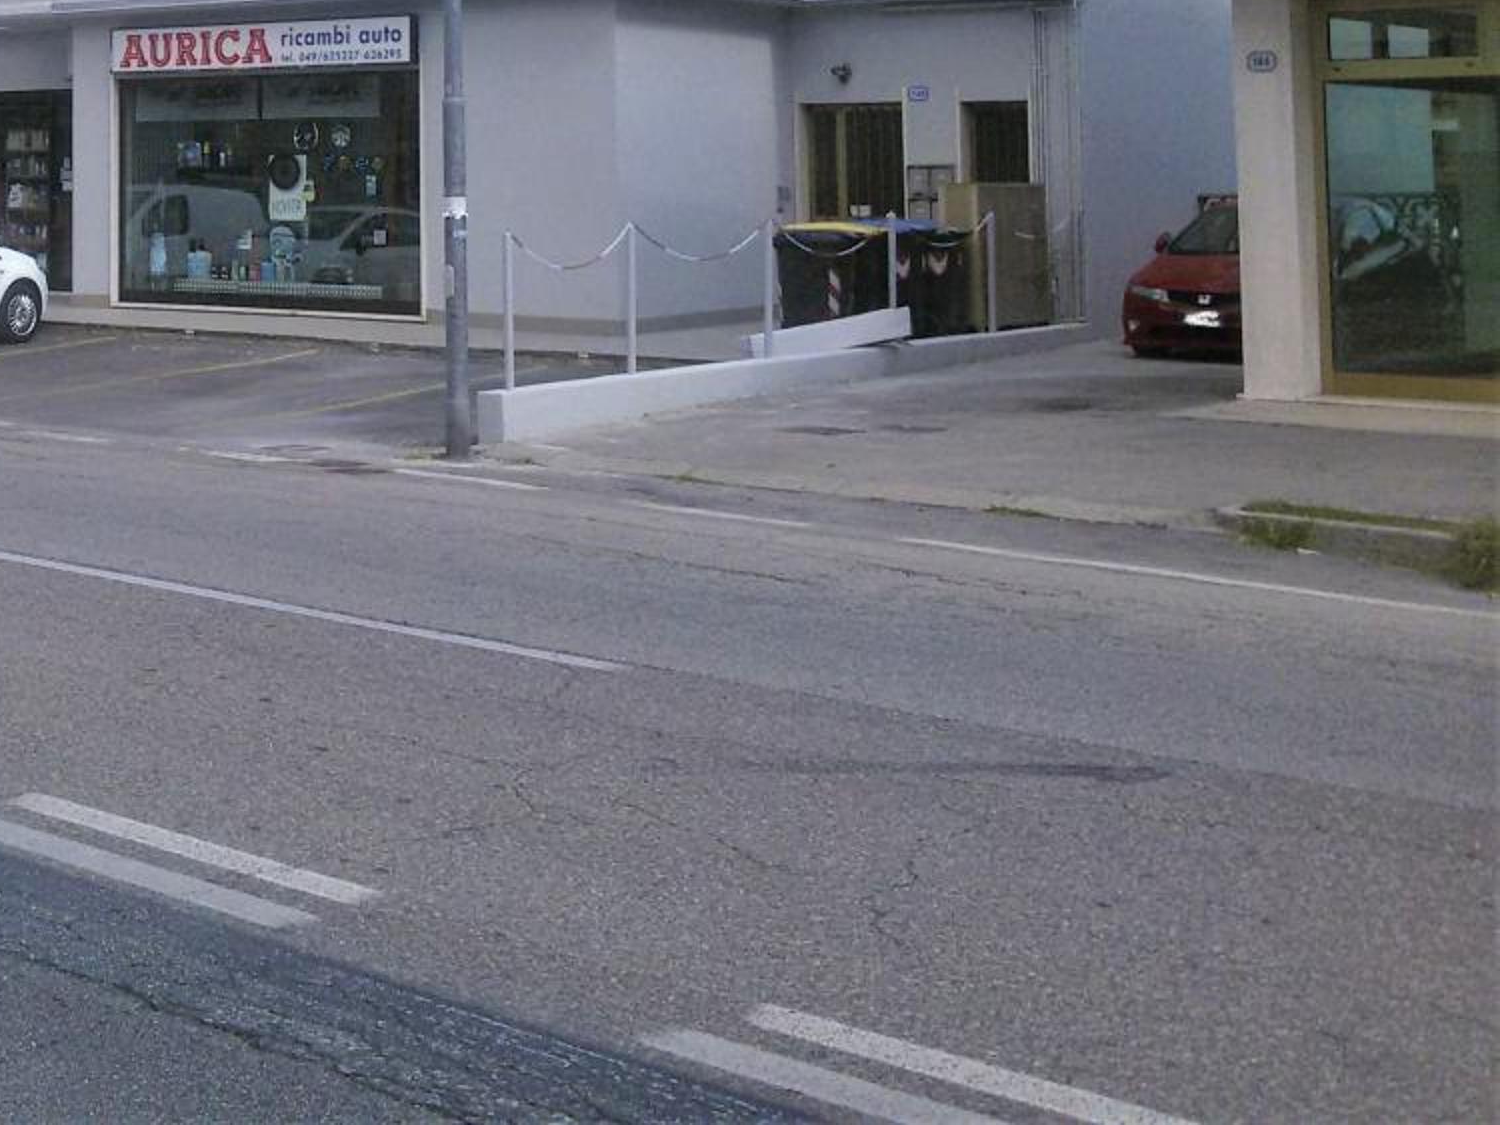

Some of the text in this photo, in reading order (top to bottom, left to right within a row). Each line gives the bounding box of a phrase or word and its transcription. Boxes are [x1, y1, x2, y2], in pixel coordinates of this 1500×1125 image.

[120, 28, 273, 68] AURICA
[280, 24, 402, 46] ricambi auto
